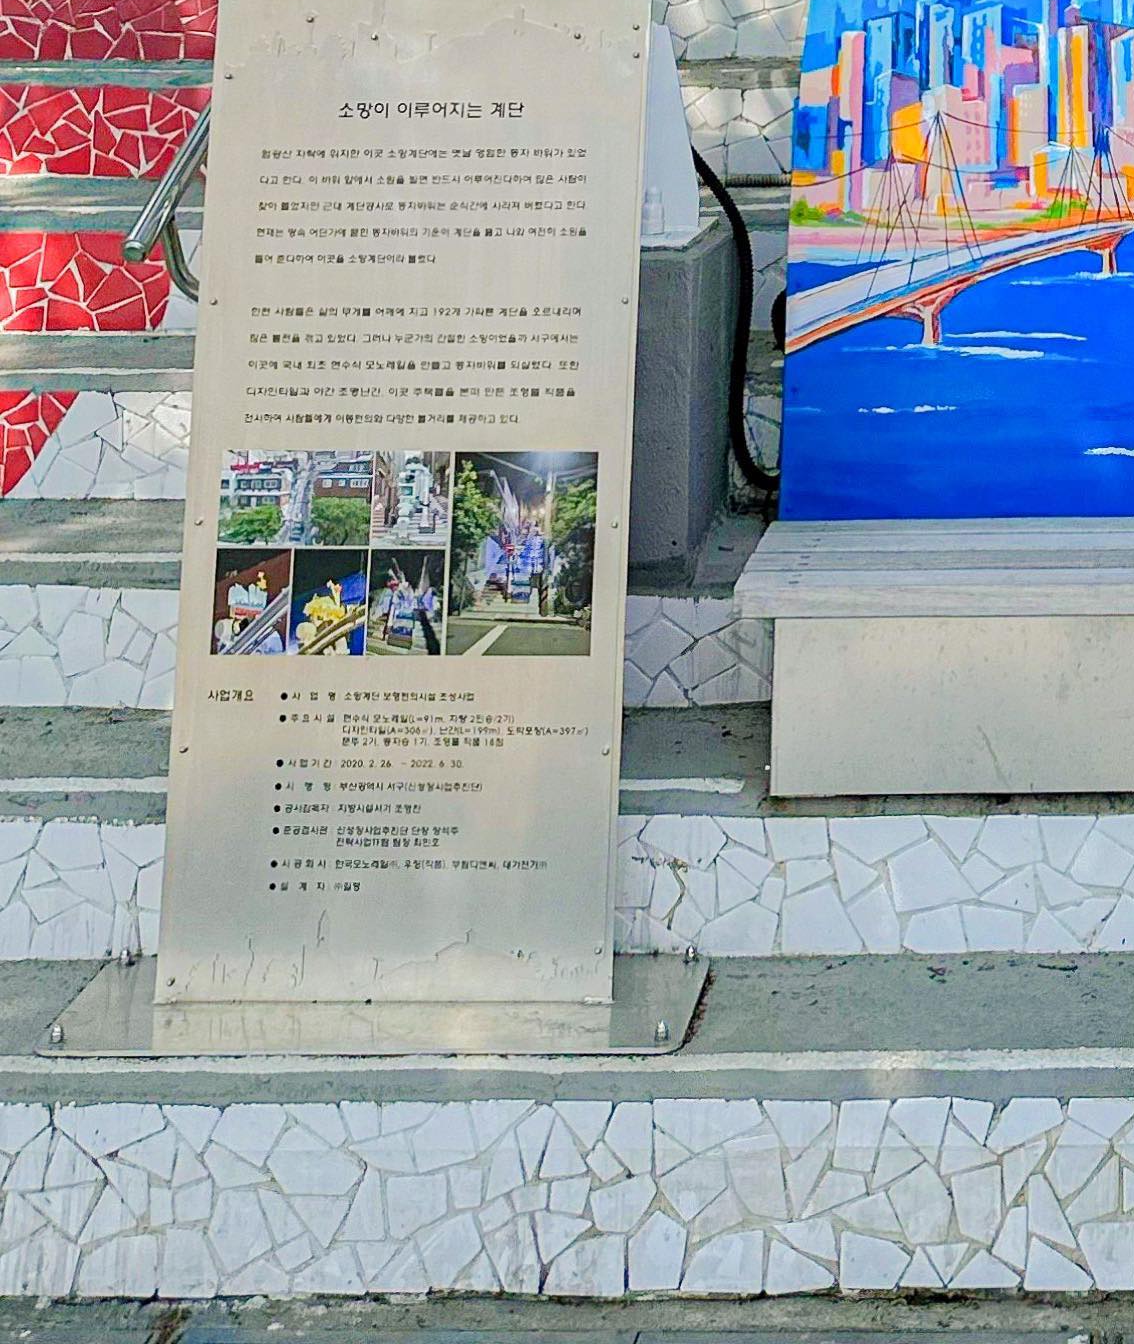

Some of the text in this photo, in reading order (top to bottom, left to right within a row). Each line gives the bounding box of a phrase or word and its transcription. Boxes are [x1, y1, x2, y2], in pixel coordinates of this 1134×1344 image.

[337, 101, 526, 120] 소망이 이루어지는 계단
[363, 148, 384, 160] 이곳
[259, 174, 279, 186] 다고
[431, 174, 461, 186] 반드시
[408, 306, 429, 318] 지고
[433, 306, 461, 318] 192개
[498, 306, 528, 318] 계단을
[207, 689, 255, 702] 사업개요
